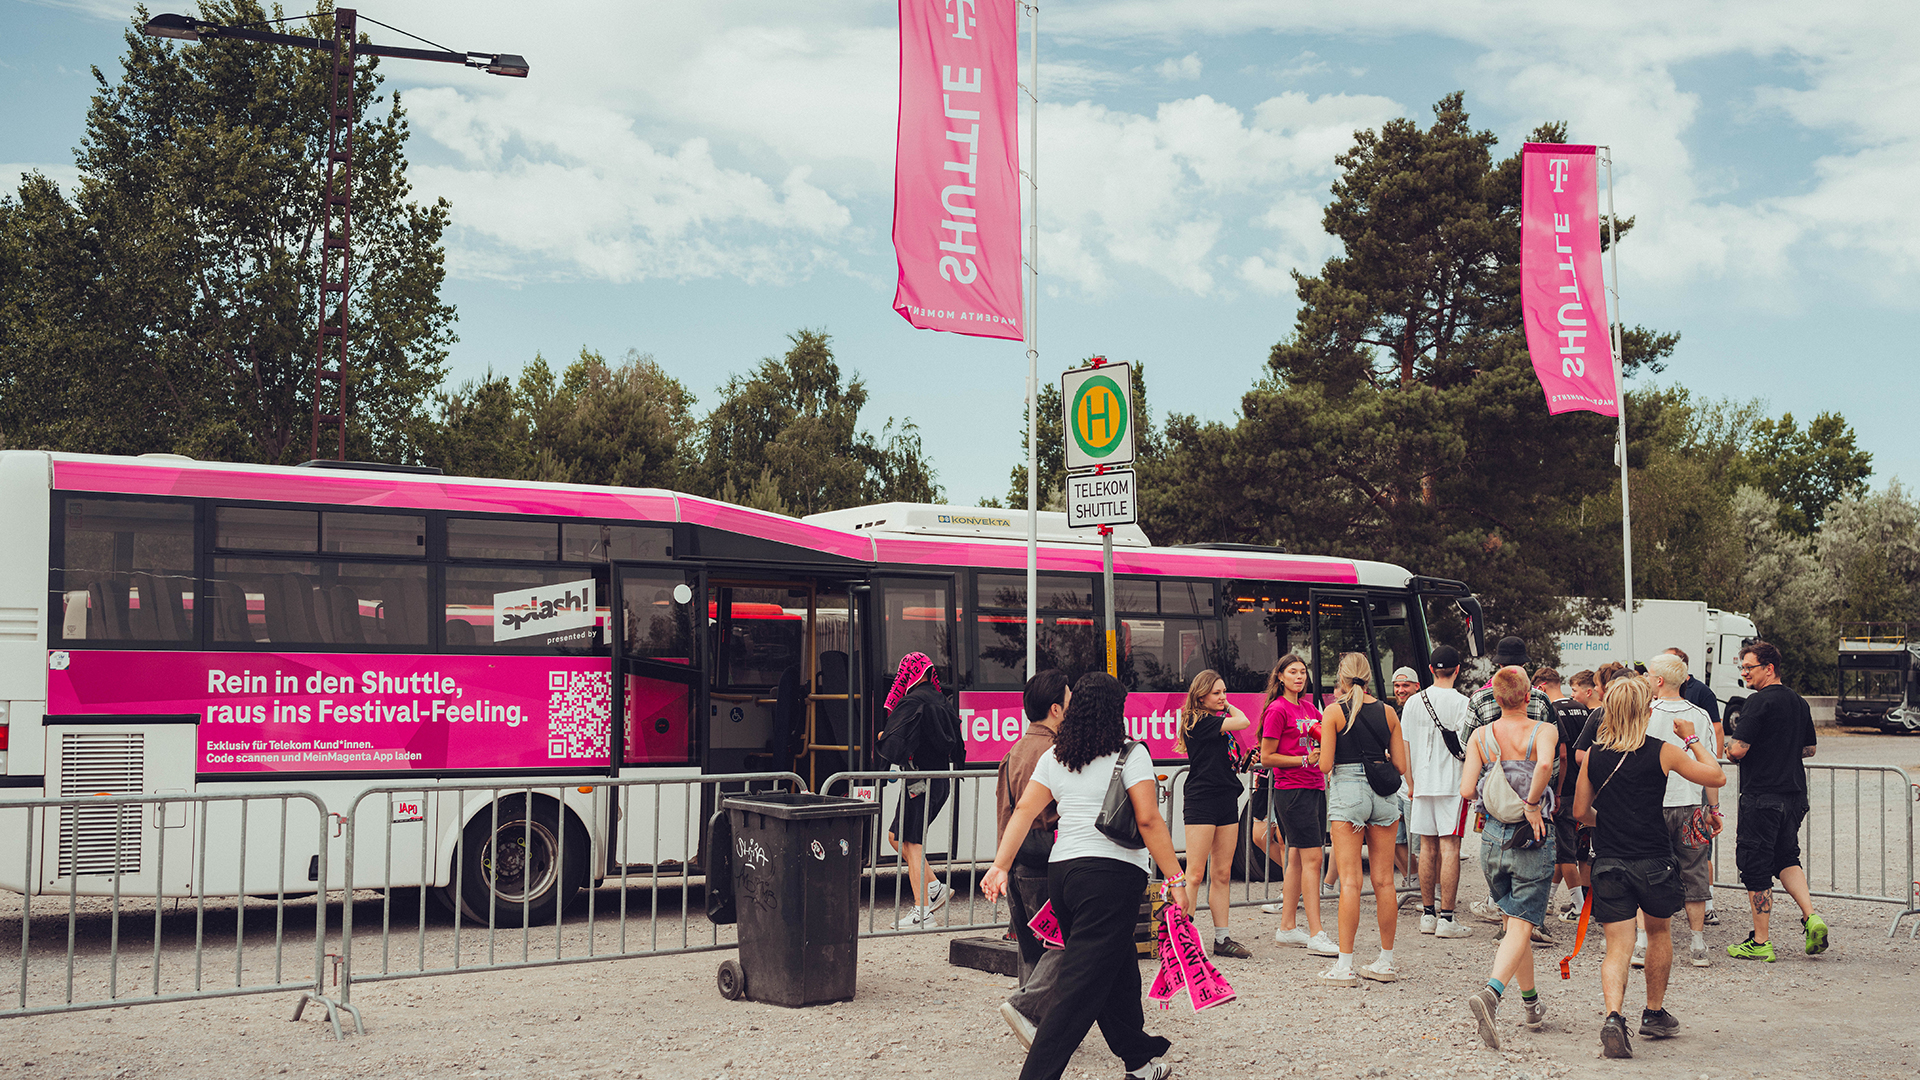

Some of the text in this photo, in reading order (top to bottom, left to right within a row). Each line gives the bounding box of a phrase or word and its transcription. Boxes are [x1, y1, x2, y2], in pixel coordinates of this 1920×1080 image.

[1086, 392, 1110, 441] H
[1074, 480, 1128, 498] TELEKOM
[1076, 501, 1127, 519] SHUTTLE
[951, 515, 1010, 527] KONVEKTA
[502, 587, 589, 631] splash!
[546, 630, 597, 645] presented by
[1561, 641, 1612, 651] einer Hand.
[208, 669, 463, 699] Rein in den Shuttle,
[207, 700, 528, 728] raus ins Festival-Feeling.
[206, 741, 250, 750] Exklusiv
[252, 740, 268, 750] für
[269, 740, 312, 750] Telekom
[206, 751, 422, 763] Code scannen und MeinMagenta App laden
